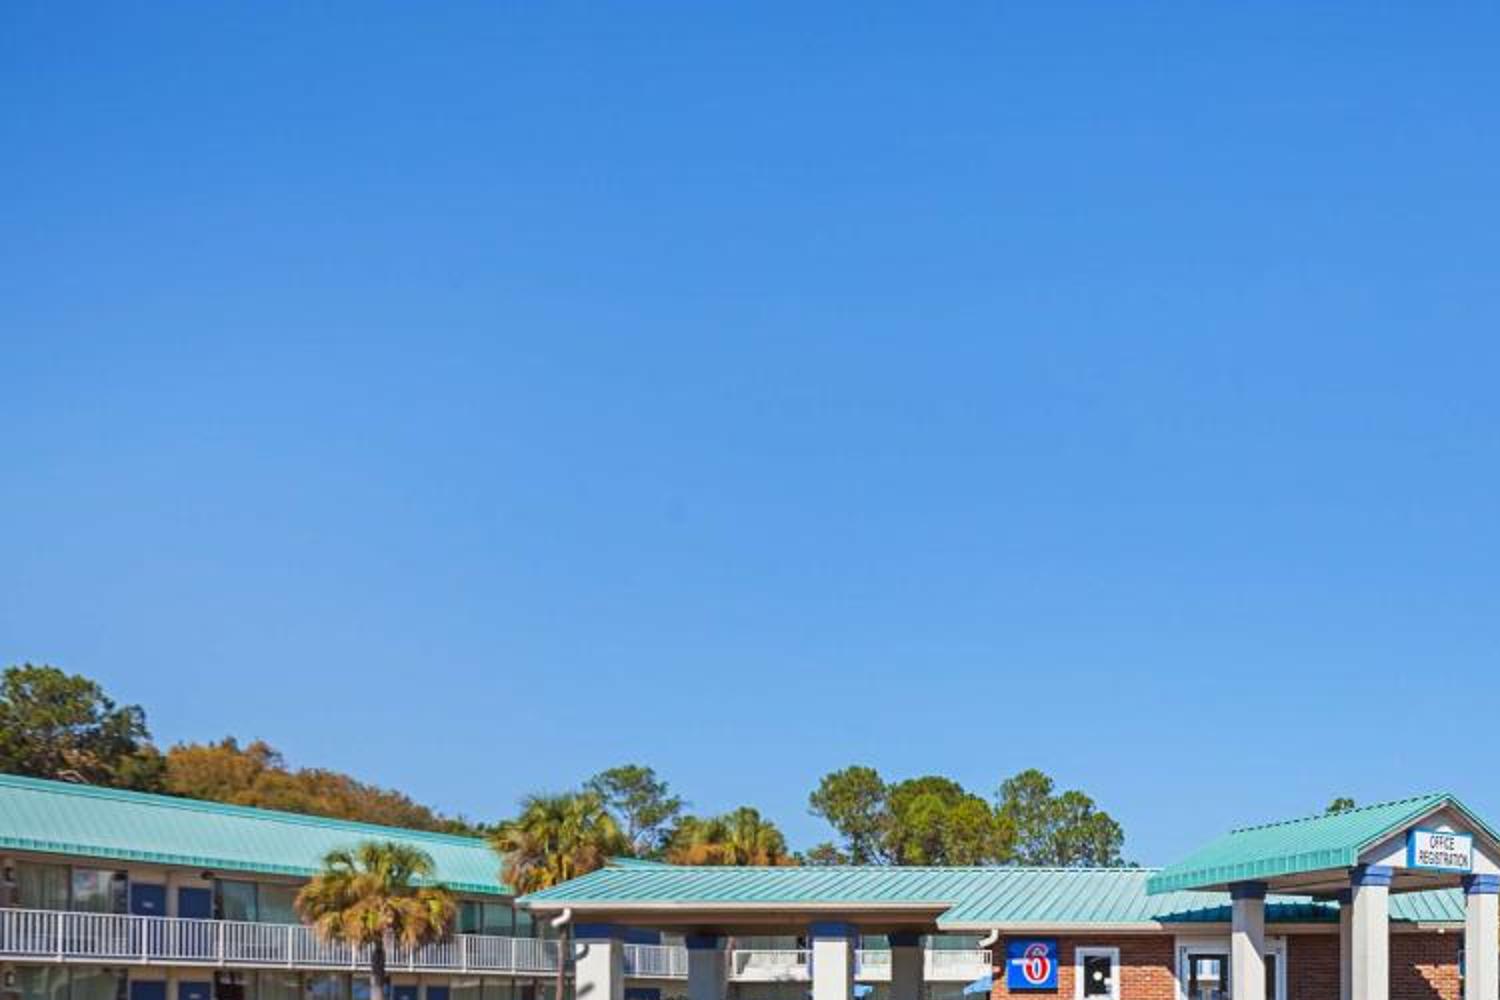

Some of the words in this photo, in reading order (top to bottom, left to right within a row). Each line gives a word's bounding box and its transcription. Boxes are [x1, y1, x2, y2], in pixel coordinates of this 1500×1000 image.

[1430, 836, 1454, 850] OFFICE
[1418, 850, 1468, 866] REGISTRATION
[1023, 943, 1051, 984] 6
